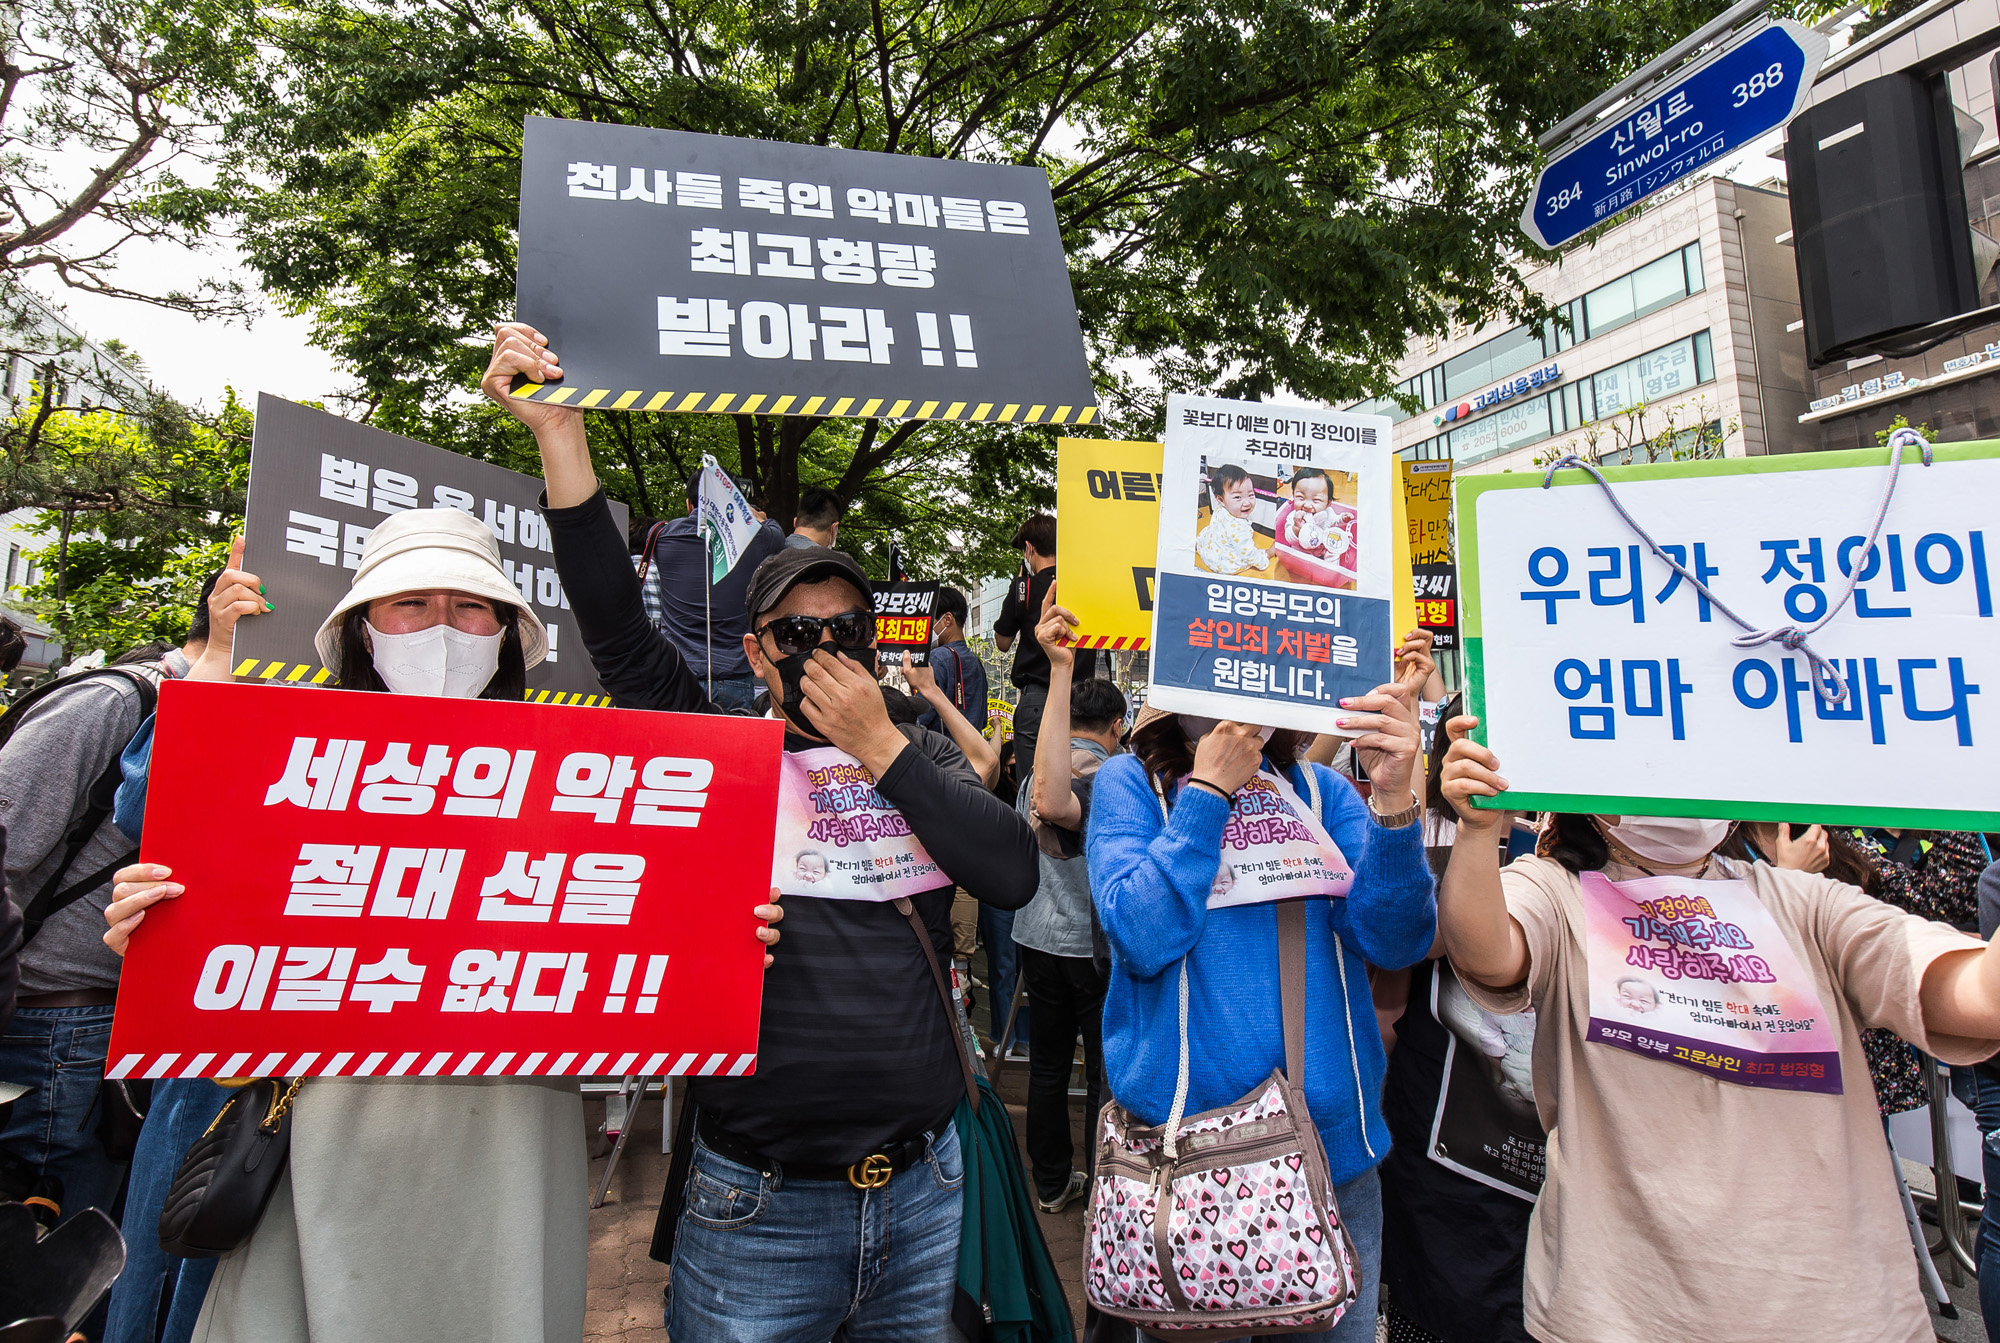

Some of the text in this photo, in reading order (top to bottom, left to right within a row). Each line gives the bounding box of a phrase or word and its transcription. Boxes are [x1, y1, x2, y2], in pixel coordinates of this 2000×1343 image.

[1731, 62, 1784, 109] 388
[1609, 90, 1694, 157] 신월로
[1605, 119, 1704, 187] Sinwol-ro
[1594, 136, 1726, 219] 新月路 シンウォルロ
[567, 160, 1029, 235] 천사들 죽인 악마들은
[1546, 180, 1584, 218] 384
[691, 228, 936, 288] 최고형량
[657, 296, 978, 367] 받아라 !!
[1637, 346, 1687, 377] 미수금
[1946, 354, 1981, 371] 변호사
[1472, 363, 1560, 412] 고려신용정보
[1646, 369, 1680, 395] 영업
[1842, 371, 1904, 401] 김형균
[1182, 408, 1378, 446] 꽃보다 예쁜 아기 정인이를
[1451, 417, 1496, 443] 미수금회수
[1474, 420, 1528, 448] 2052 6000
[1245, 438, 1313, 462] 추모하며
[319, 452, 418, 515] 법은
[715, 468, 734, 494] STOP!
[1520, 530, 1995, 626] 우리가 정인이
[1206, 583, 1342, 628] 입양부모의
[1188, 618, 1360, 668] 살인죄 처벌을
[1213, 658, 1332, 700] 원합니다.
[1553, 656, 1981, 747] 엄마 아빠다
[263, 736, 714, 828] 세상의 악은
[852, 869, 902, 884] 엄마아빠여서
[903, 866, 911, 878] 전
[861, 859, 874, 871] 힘든
[874, 856, 893, 868] 학대
[895, 852, 914, 866] 속에도
[1258, 870, 1312, 886] 엄마아빠여서
[1313, 869, 1322, 879] 전
[1265, 859, 1282, 871] 힘든
[1282, 857, 1302, 868] 학대
[1304, 856, 1324, 867] 속에도
[282, 842, 646, 925] 절대 선을
[1653, 895, 1717, 921] 정인이를
[194, 943, 670, 1014] 이길수 없다 !!
[1626, 945, 1777, 984] 사랑해주세요
[1690, 1011, 1762, 1032] 엄마아빠여서
[1764, 1020, 1776, 1033] 전
[1702, 998, 1722, 1014] 힘든
[1726, 1002, 1750, 1015] 학대
[1752, 1004, 1781, 1016] 속에도
[1601, 1027, 1825, 1078] 양모 양부 고문살인 최고 법정형
[1502, 1144, 1510, 1154] 이
[1513, 1148, 1530, 1160] 땅의
[1502, 1154, 1520, 1166] 여린
[1508, 1136, 1516, 1146] 또
[1518, 1141, 1535, 1152] 다른
[1502, 1162, 1528, 1178] 우리의
